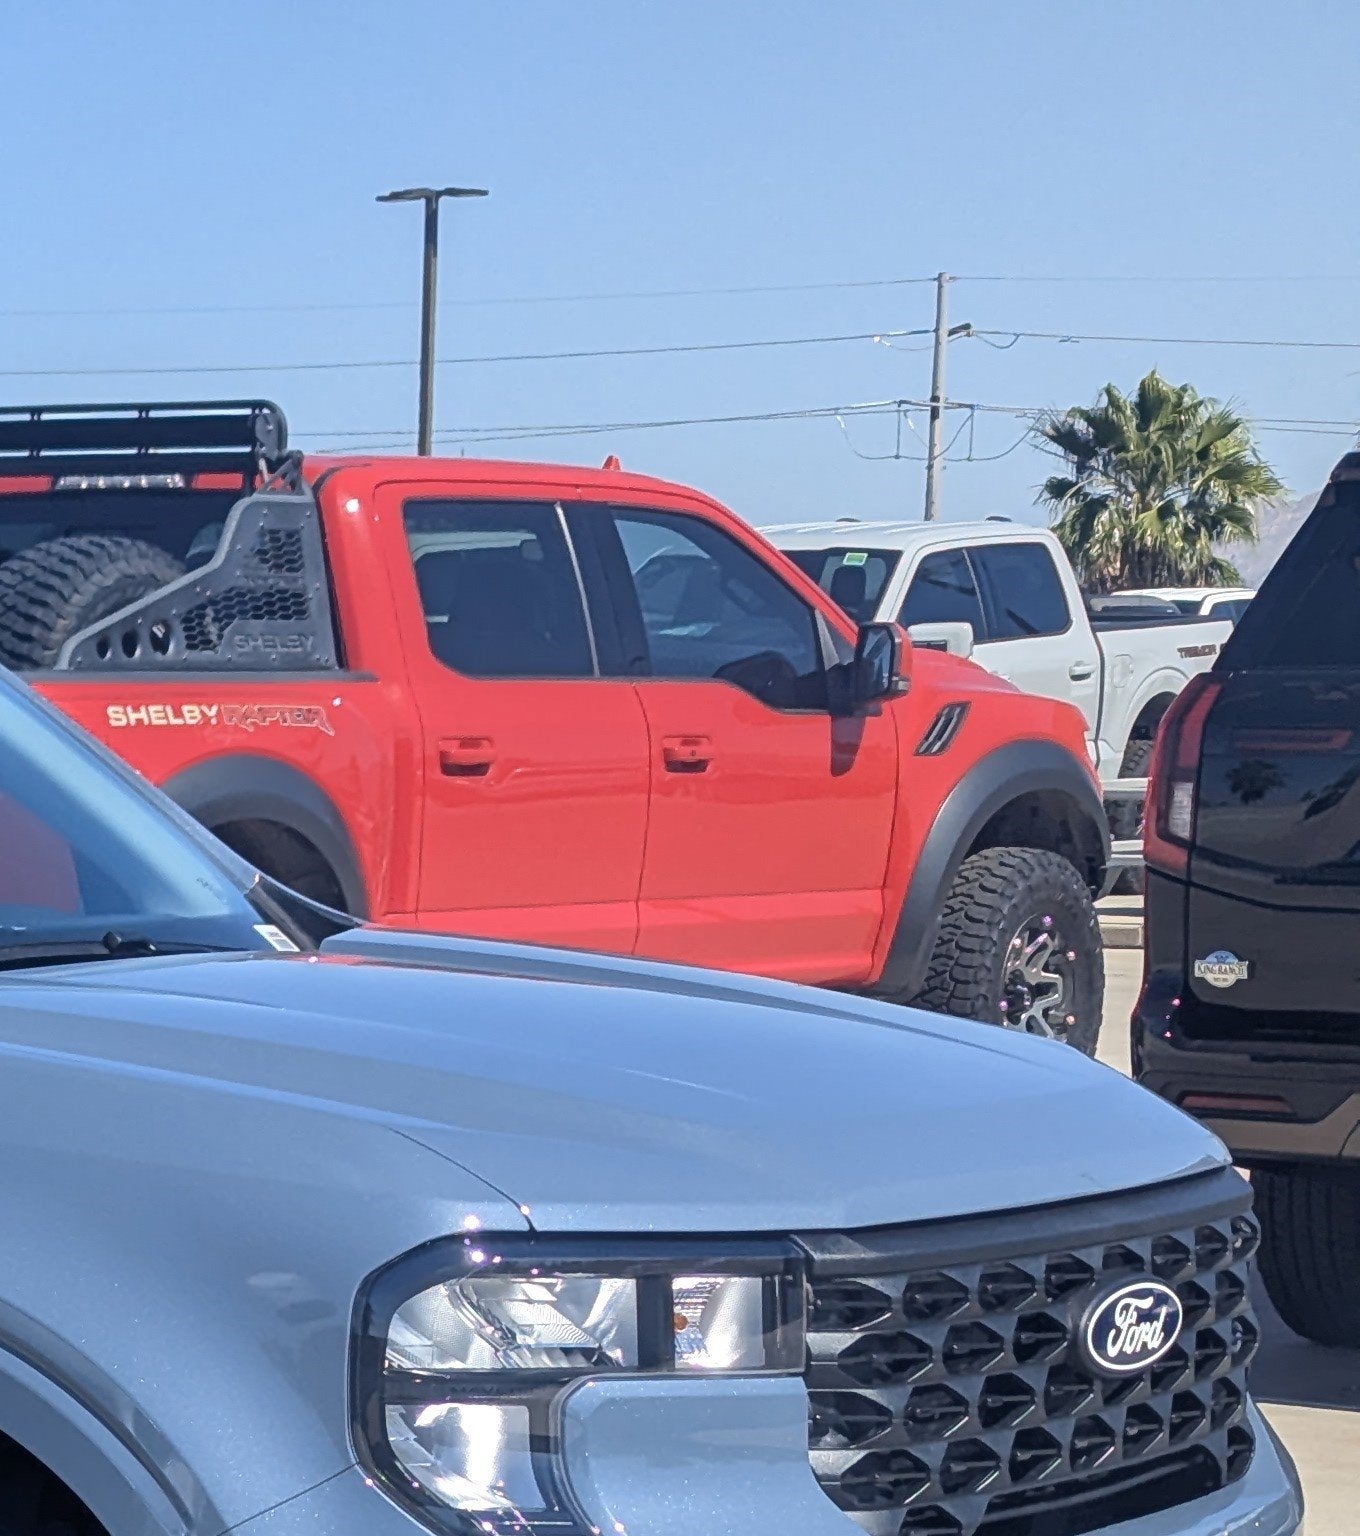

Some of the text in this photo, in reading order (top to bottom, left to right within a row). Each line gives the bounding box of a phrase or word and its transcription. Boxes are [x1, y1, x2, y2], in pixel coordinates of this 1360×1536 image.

[234, 633, 315, 652] SHELBY
[106, 704, 336, 736] SHELBY RAPTOR
[1105, 1294, 1169, 1358] Ford
